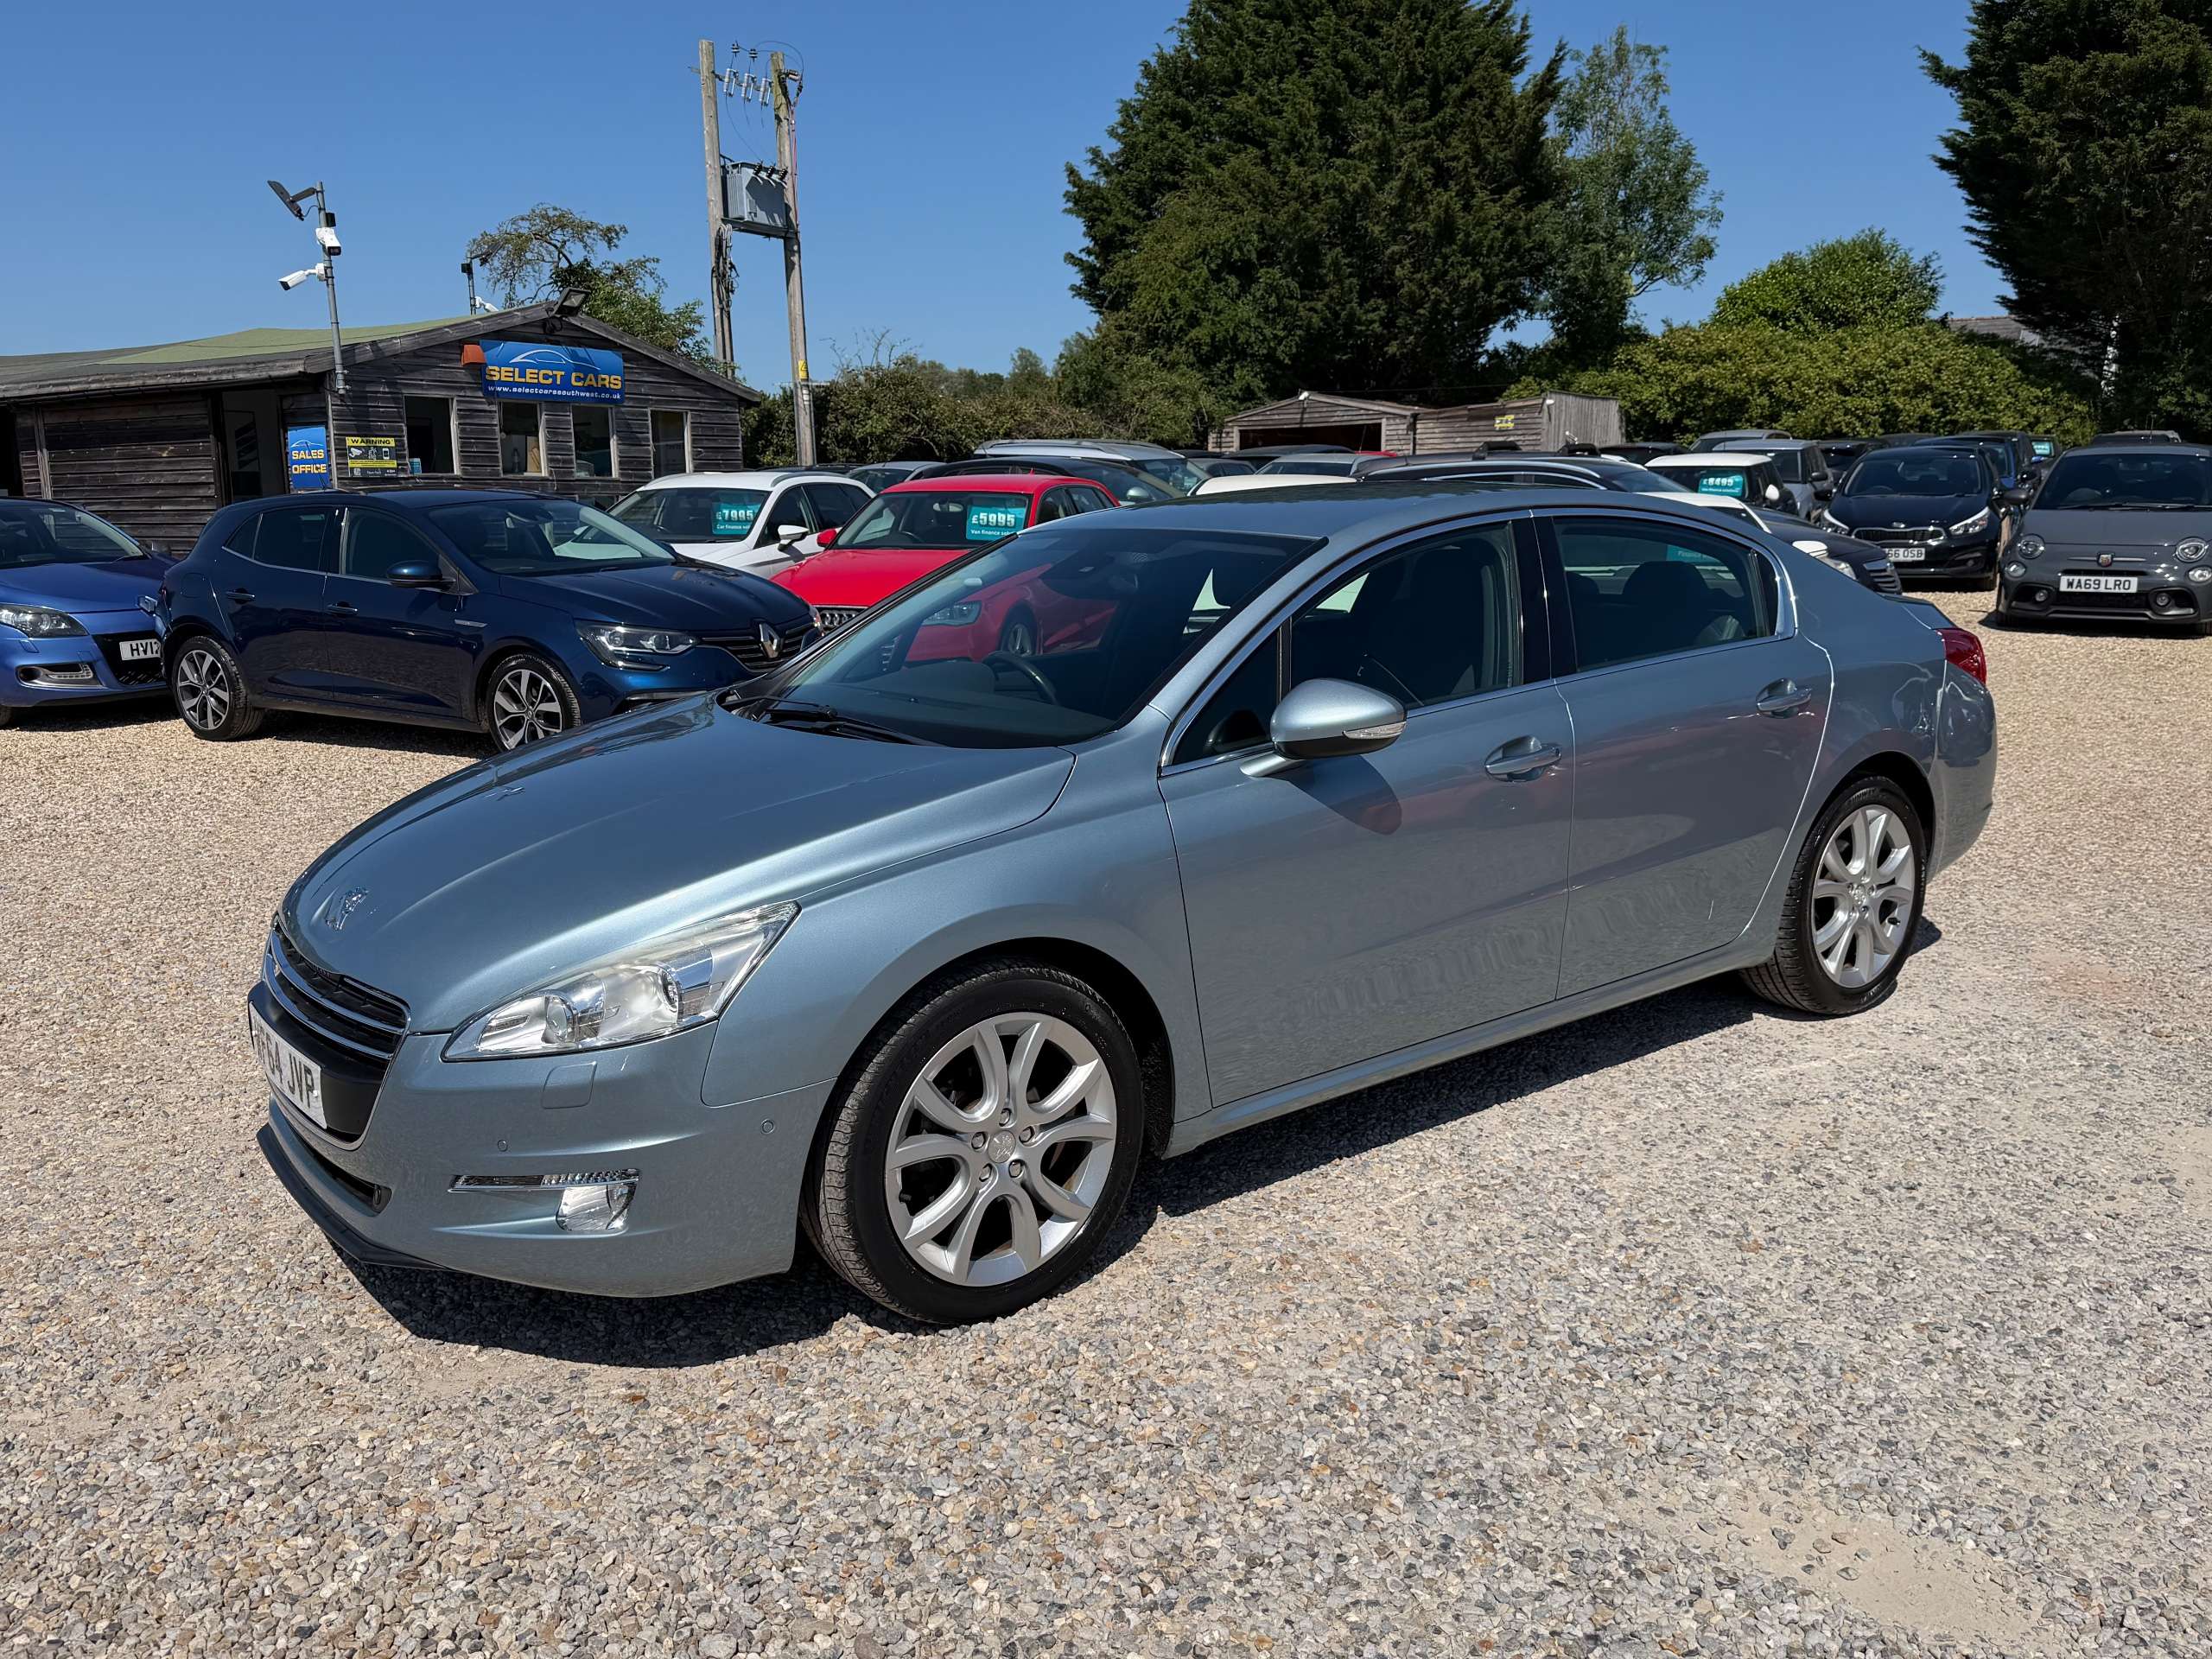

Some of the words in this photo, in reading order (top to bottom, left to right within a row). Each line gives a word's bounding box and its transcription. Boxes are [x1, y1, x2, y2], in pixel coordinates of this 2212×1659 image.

[485, 365, 565, 385] SELECT
[571, 372, 622, 390] CARS
[488, 385, 621, 399] www.selectcarssouthwest.co.uk
[291, 449, 325, 460] SALES
[292, 463, 327, 474] OFFICE
[715, 509, 753, 521] £7995
[971, 512, 1016, 527] £5995
[1903, 550, 1923, 558] OSB
[2066, 578, 2101, 590] WA69
[2104, 579, 2132, 591] LRO
[287, 1052, 315, 1109] JVP
